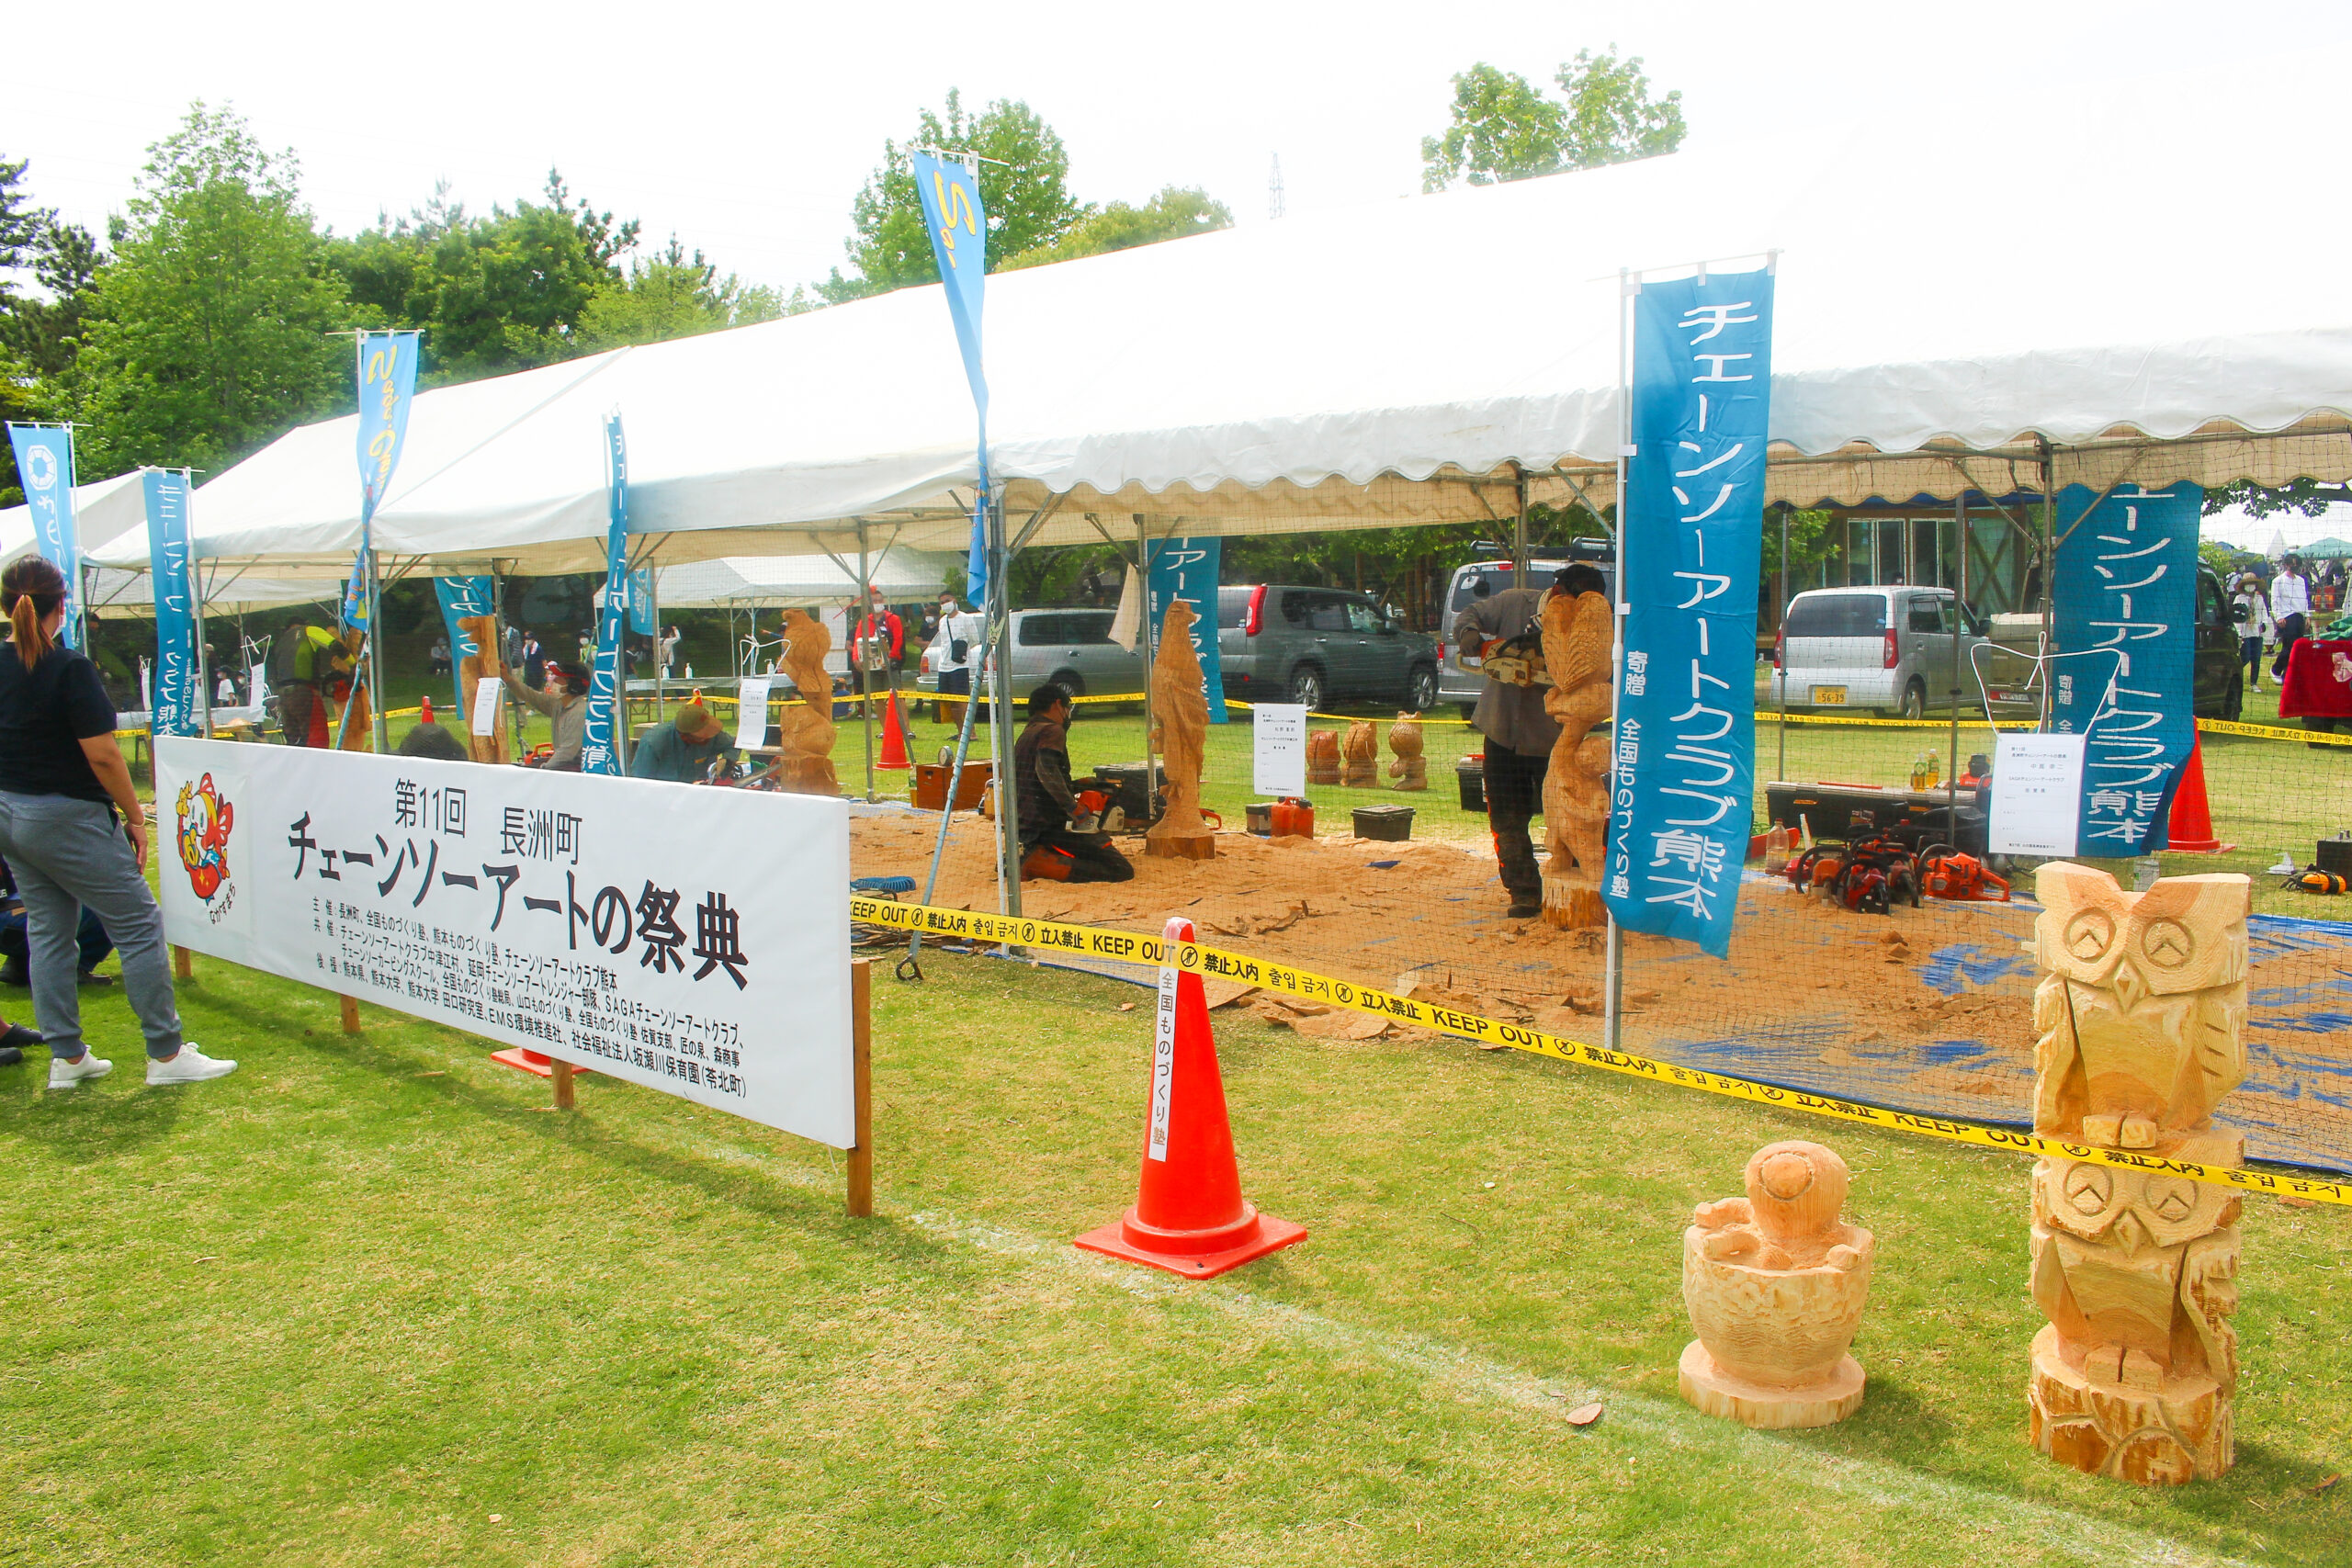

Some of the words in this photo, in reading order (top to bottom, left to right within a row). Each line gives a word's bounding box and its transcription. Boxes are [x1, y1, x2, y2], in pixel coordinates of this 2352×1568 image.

[1623, 650, 1648, 696] 寄贈
[394, 777, 467, 839] 第11回
[500, 806, 583, 866] 長洲町
[1609, 717, 1643, 899] 全国ものづくり塾
[288, 810, 749, 991] チェーンソーアートの祭典
[881, 906, 908, 924] OUT
[927, 912, 967, 933] 禁止入内
[973, 918, 994, 936] 출입
[997, 922, 1018, 941] 금지
[1040, 928, 1085, 950] 立入禁止
[1092, 934, 1135, 956] KEEP
[1142, 941, 1176, 963] OUT
[1204, 953, 1260, 982] 禁止入内
[1268, 967, 1297, 989] 출입
[1301, 976, 1329, 998] 금지
[1361, 990, 1422, 1021] 立入禁止
[1432, 1008, 1489, 1034] KEEP
[1499, 1025, 1544, 1049] OUT
[1152, 971, 1175, 1146] 全国ものづくり塾
[1584, 1045, 1657, 1075] 禁止入内
[1796, 1093, 1879, 1119] 立入禁止
[1893, 1112, 1971, 1135] KEEP
[1985, 1130, 2047, 1150] OUT
[2104, 1150, 2205, 1177] 禁止入内
